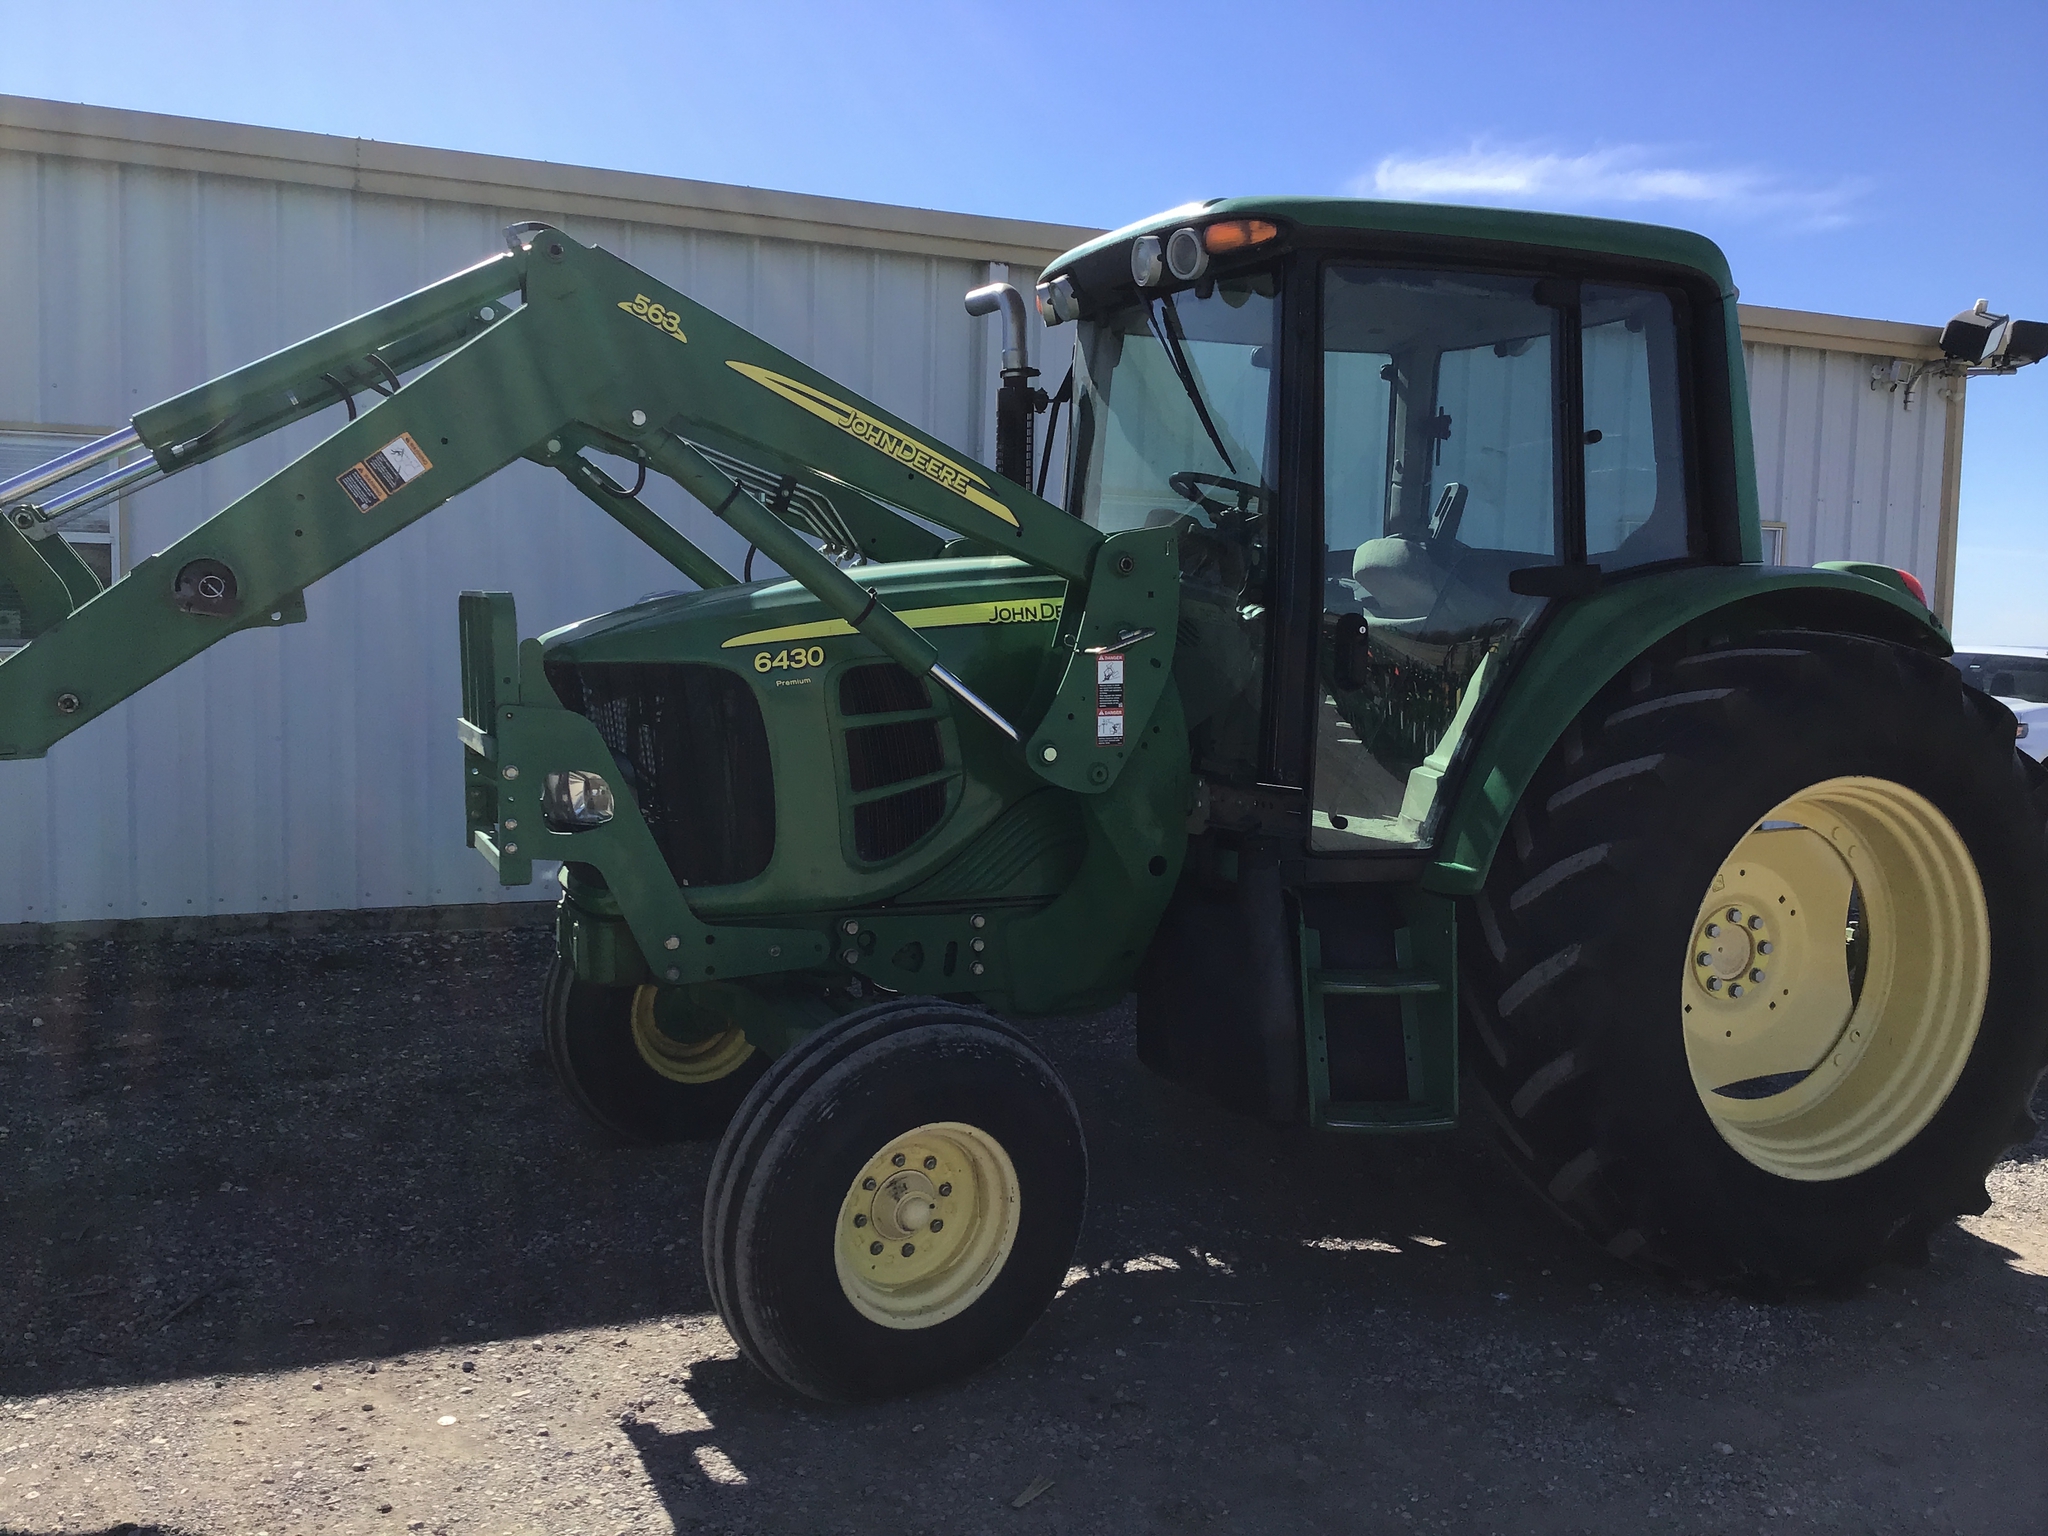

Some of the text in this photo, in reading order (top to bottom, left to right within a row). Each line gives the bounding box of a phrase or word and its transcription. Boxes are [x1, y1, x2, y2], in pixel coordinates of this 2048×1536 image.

[632, 293, 681, 332] 563
[838, 411, 970, 493] JOHN DEERE
[989, 606, 1037, 622] JOHN
[754, 646, 824, 673] 6430
[776, 678, 812, 687] Premium
